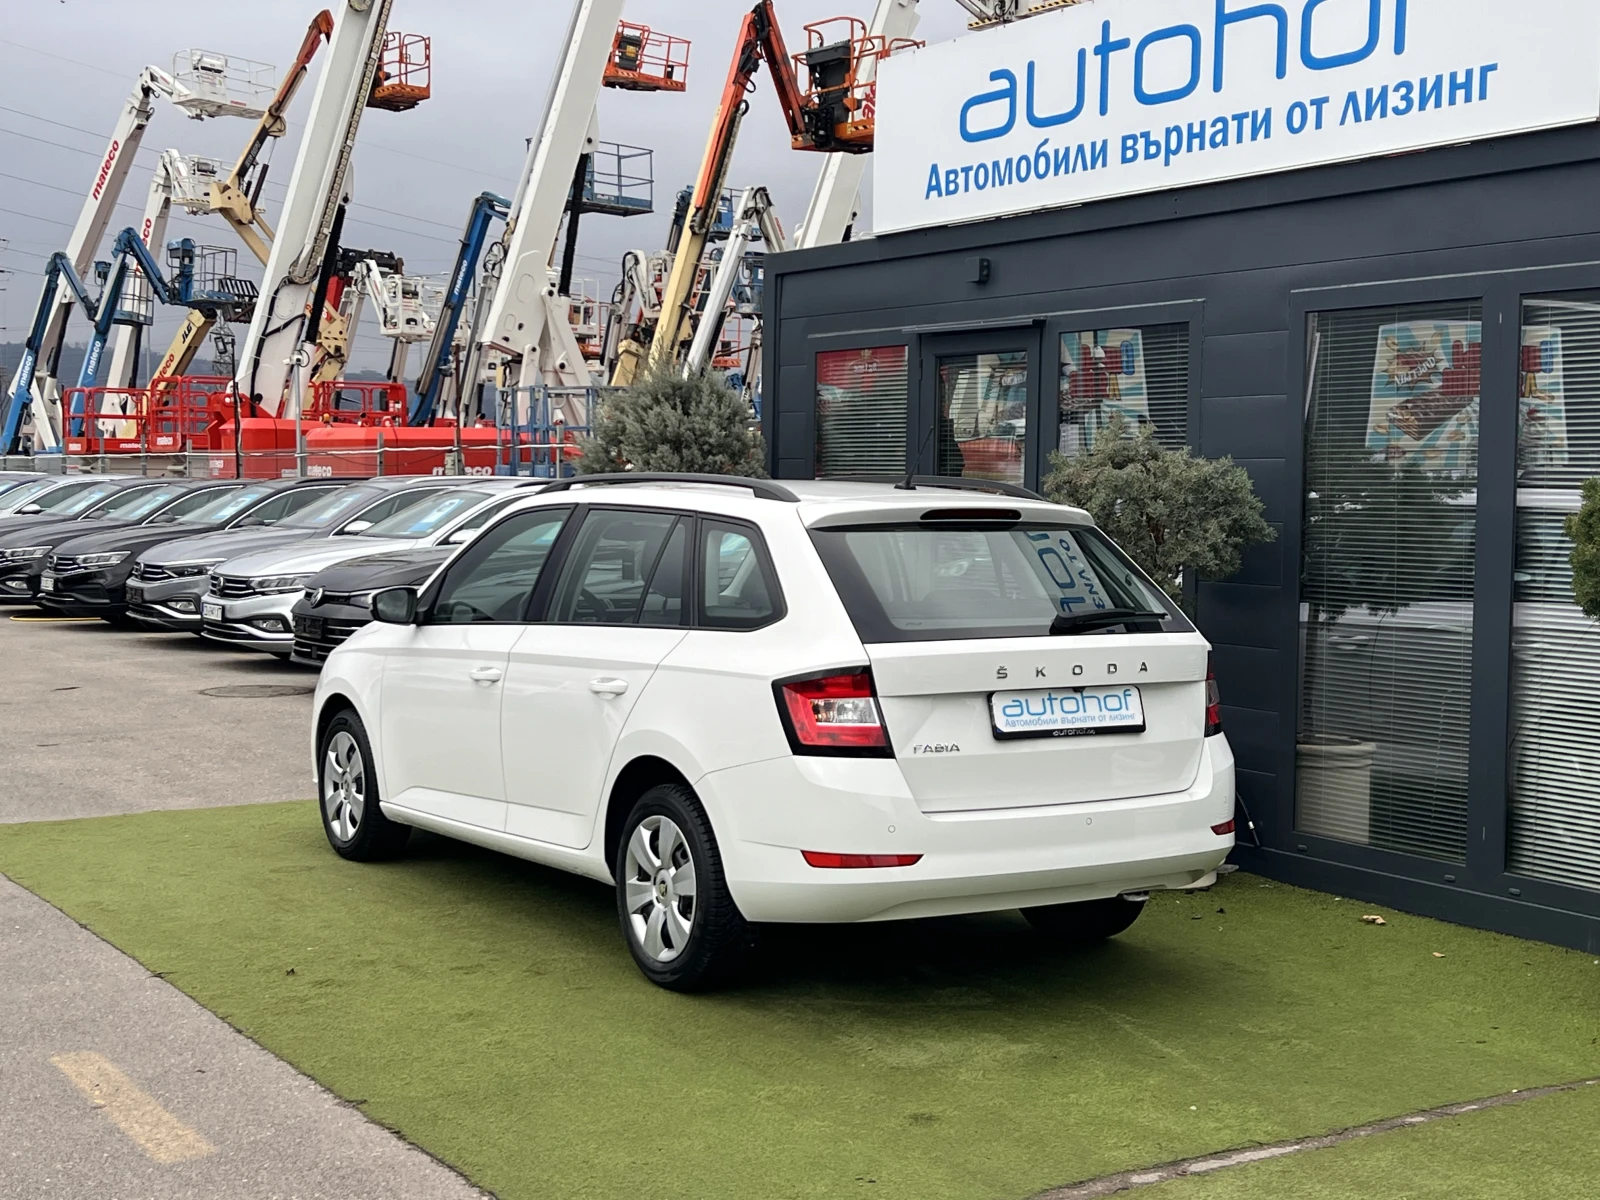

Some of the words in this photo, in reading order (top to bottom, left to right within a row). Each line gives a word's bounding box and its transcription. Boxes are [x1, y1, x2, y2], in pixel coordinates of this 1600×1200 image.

[925, 138, 1108, 200] Автомобили
[1120, 107, 1272, 167] върнати
[1286, 96, 1330, 135] от
[1339, 63, 1498, 126] лизинг
[92, 140, 119, 200] mateco
[454, 260, 468, 295] mateco
[182, 323, 193, 344] JLG
[20, 355, 33, 386] mateco
[87, 341, 101, 375] mateco
[432, 466, 493, 476] meco
[996, 662, 1148, 680] ŠKODA
[1002, 689, 1132, 717] autohof
[1005, 715, 1059, 728] Автомобили
[1061, 715, 1096, 725] върнати
[1098, 714, 1107, 722] от
[1109, 712, 1136, 722] лизинг
[913, 743, 961, 755] FABIA
